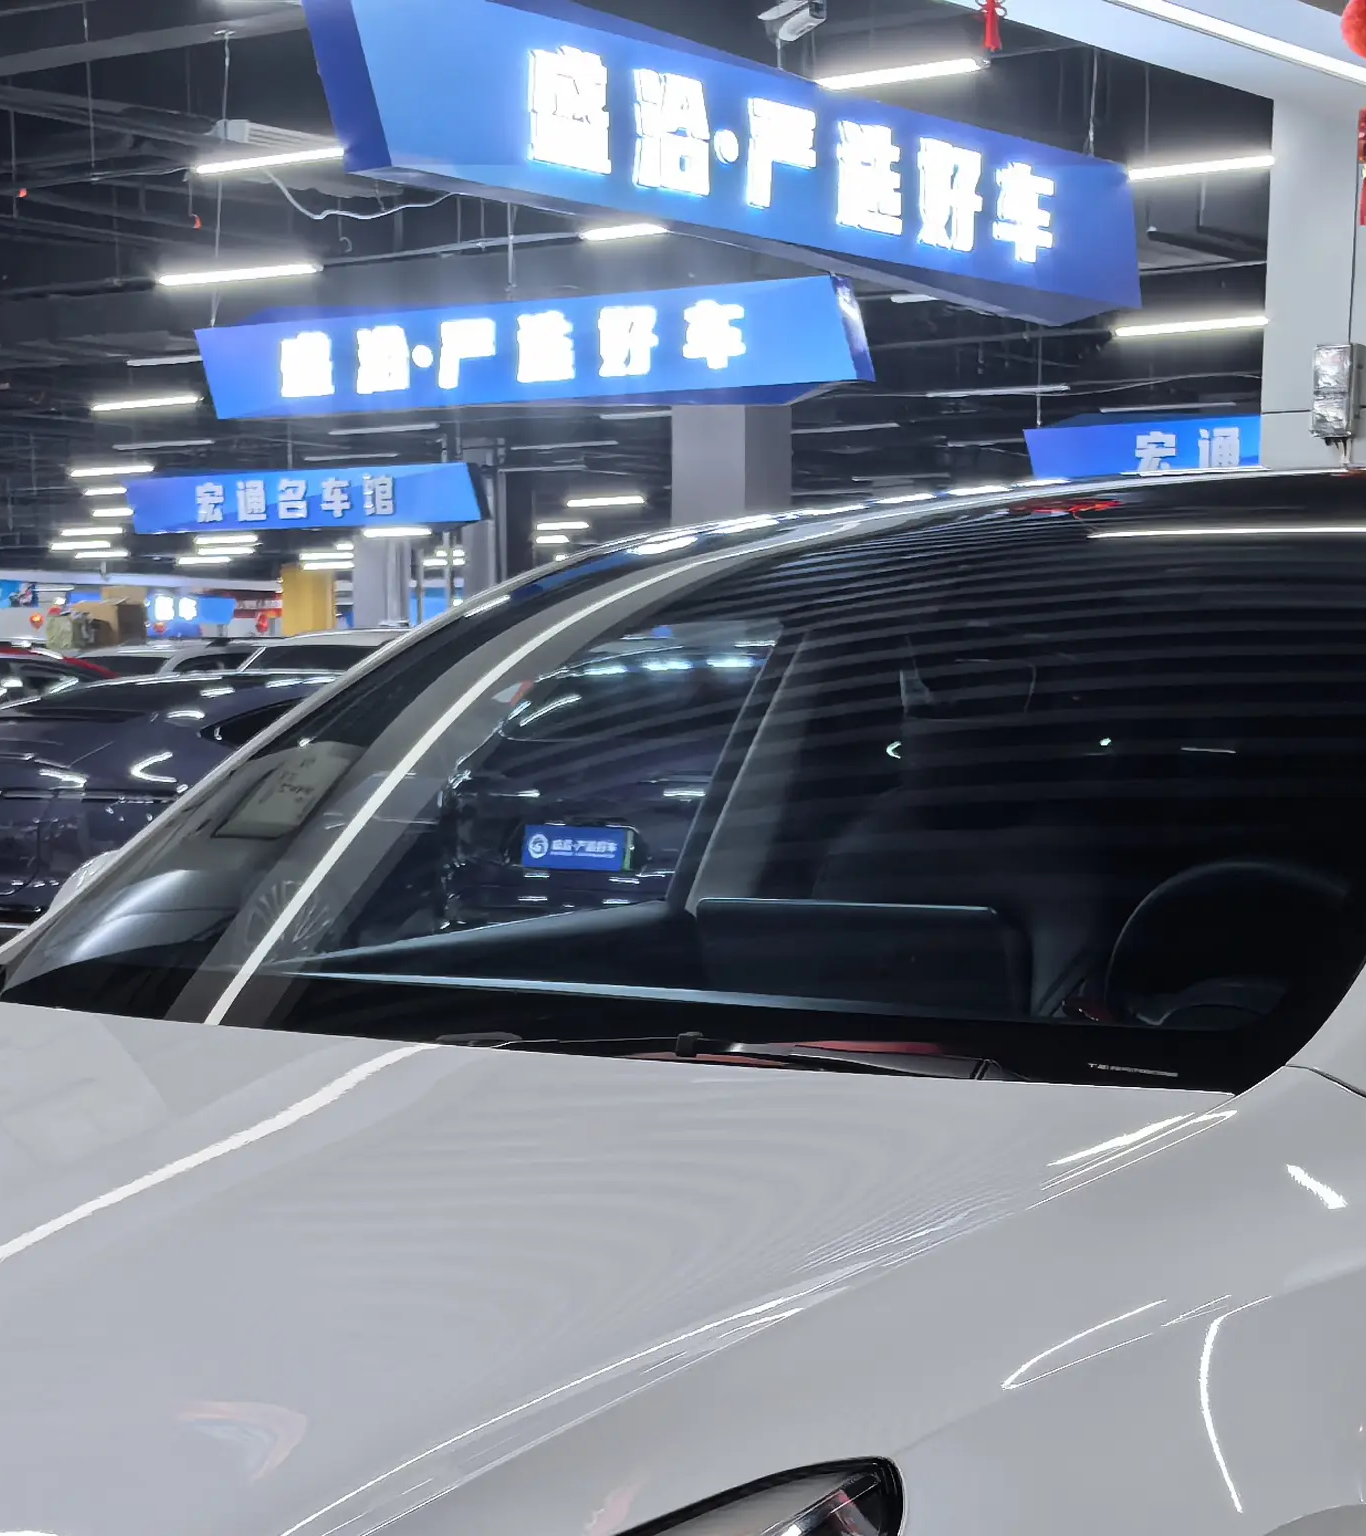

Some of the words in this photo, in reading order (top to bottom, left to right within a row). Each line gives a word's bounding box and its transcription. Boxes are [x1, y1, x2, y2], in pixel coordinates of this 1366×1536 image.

[195, 473, 394, 522] 宏通名车馆
